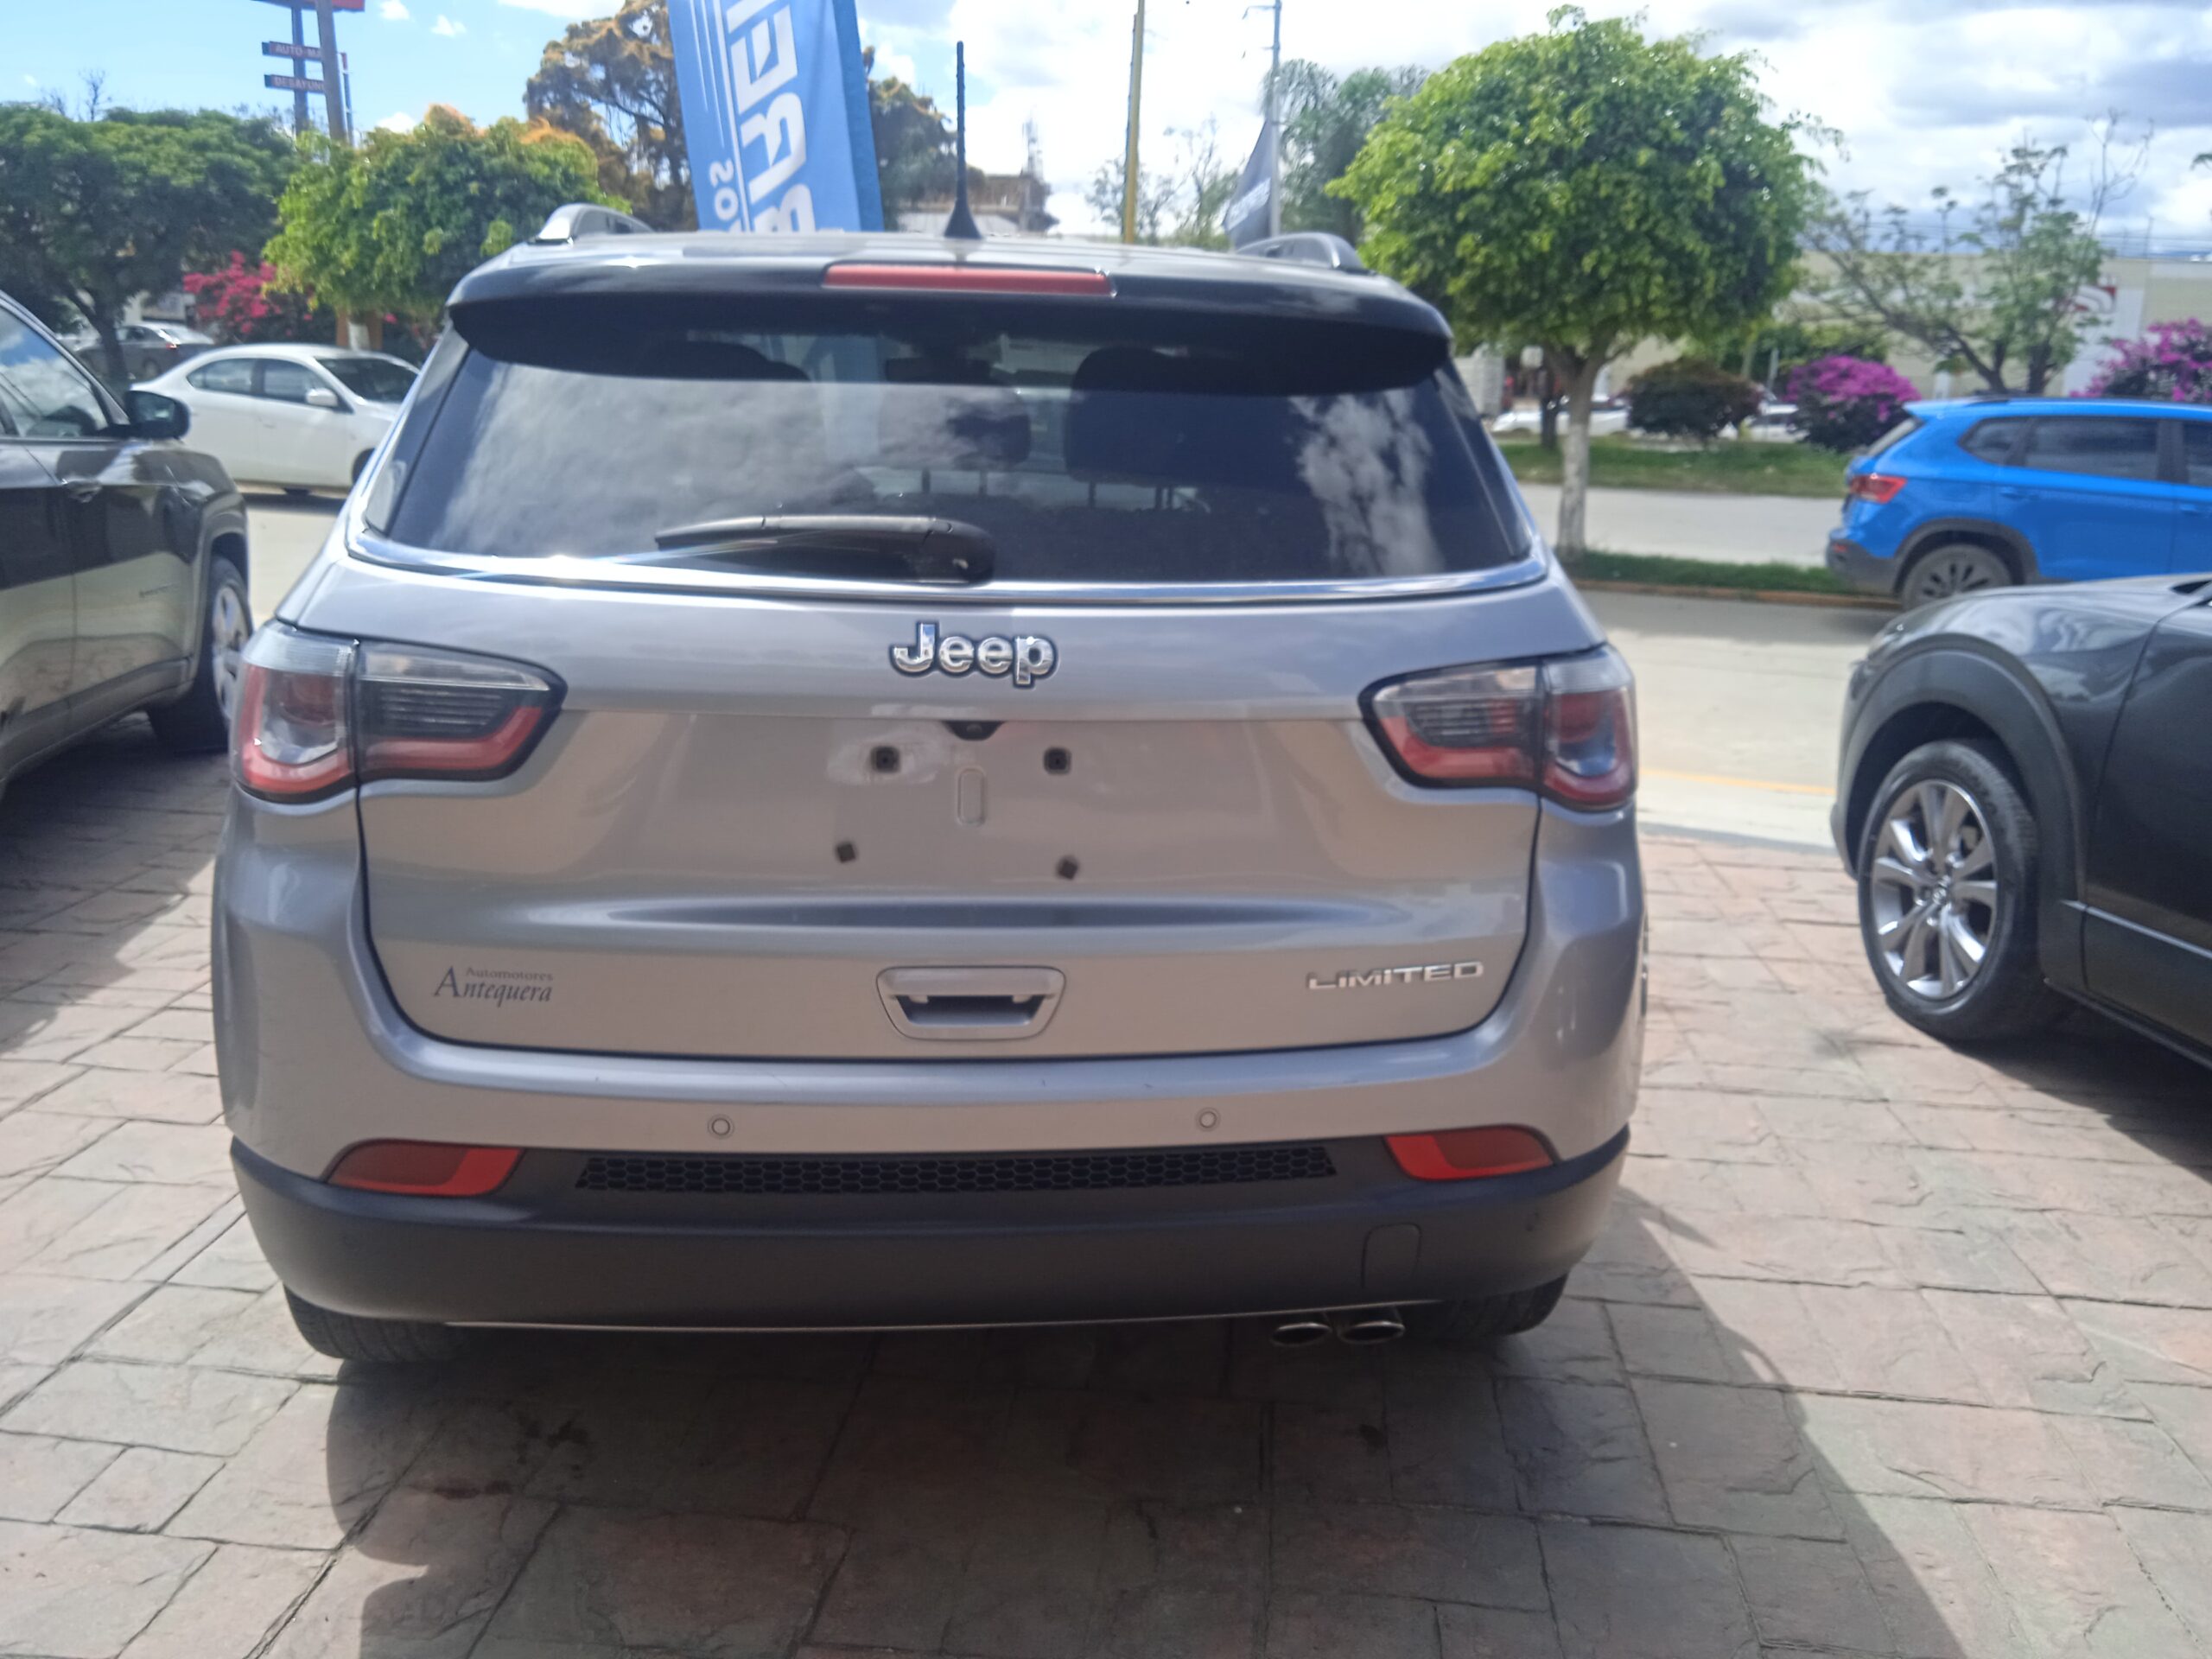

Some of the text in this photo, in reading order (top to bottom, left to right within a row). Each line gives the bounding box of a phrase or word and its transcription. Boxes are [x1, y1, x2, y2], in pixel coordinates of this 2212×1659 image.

[275, 43, 302, 56] AUTO
[889, 621, 1058, 688] Jeep
[434, 965, 553, 1008] Antequera
[465, 967, 553, 982] Automotores
[1307, 961, 1484, 990] LIMITED
